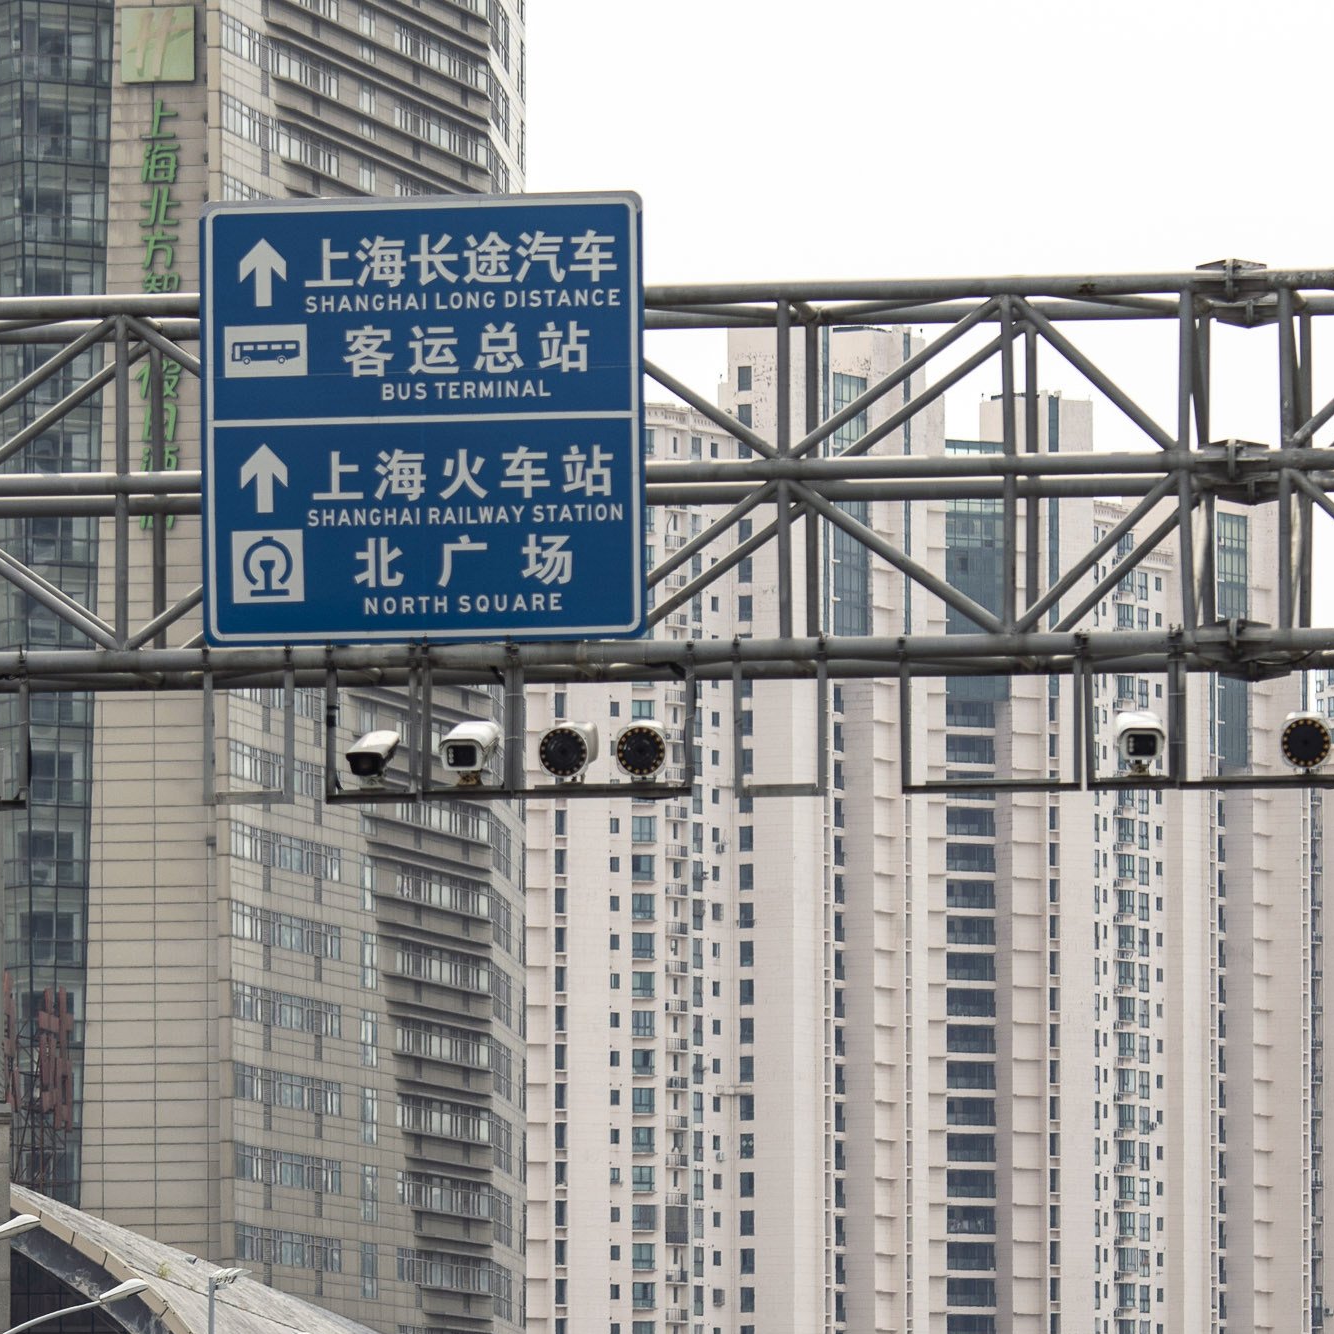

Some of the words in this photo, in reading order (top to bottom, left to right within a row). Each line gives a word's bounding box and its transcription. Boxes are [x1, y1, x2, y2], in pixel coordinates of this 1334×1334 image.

[304, 229, 619, 290] 上海长途汽车
[305, 293, 428, 314] SHANGHAI
[435, 290, 496, 310] LONG
[504, 288, 621, 308] DISTANCE
[342, 320, 591, 378] 客运总站
[381, 382, 427, 401] BUS
[434, 379, 552, 400] TERMINAL
[312, 444, 615, 502] 上海火车站
[307, 507, 422, 527] SHANGHAI
[428, 505, 525, 525] RAILWAY
[532, 502, 624, 523] STATION
[354, 534, 574, 588] 北广场
[364, 596, 448, 615] NORTH
[458, 592, 563, 614] SQUARE
